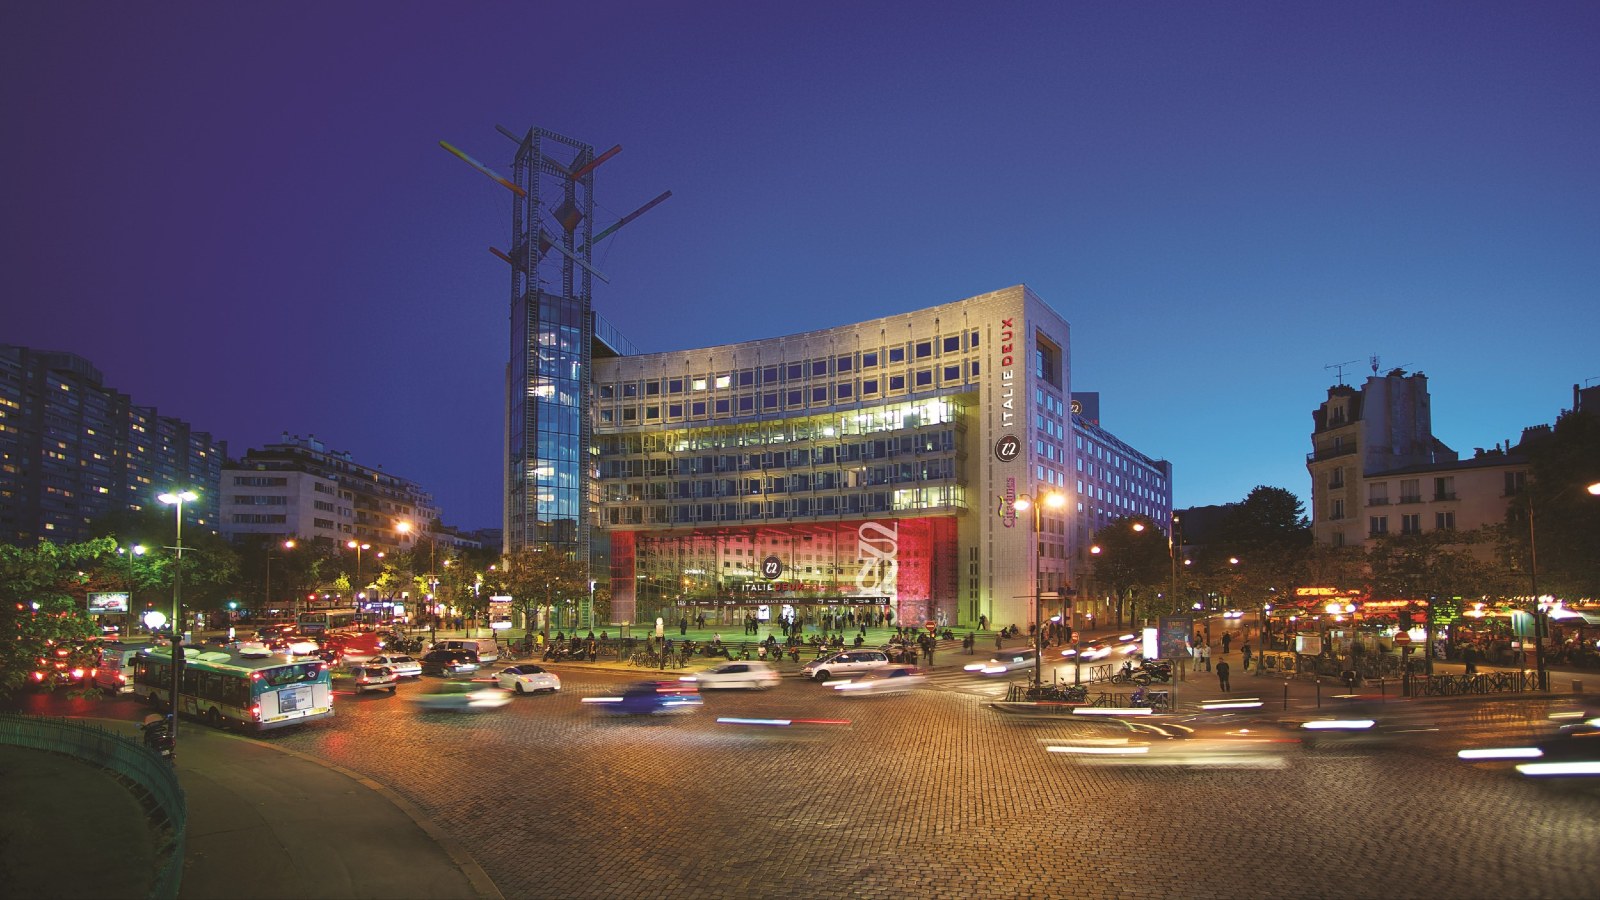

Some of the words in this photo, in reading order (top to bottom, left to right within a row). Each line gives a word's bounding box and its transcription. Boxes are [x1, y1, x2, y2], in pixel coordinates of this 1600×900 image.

[1002, 318, 1013, 366] DEUX
[1002, 370, 1013, 427] ITALIE
[1003, 477, 1015, 528] Citadines
[774, 583, 804, 591] DEUX
